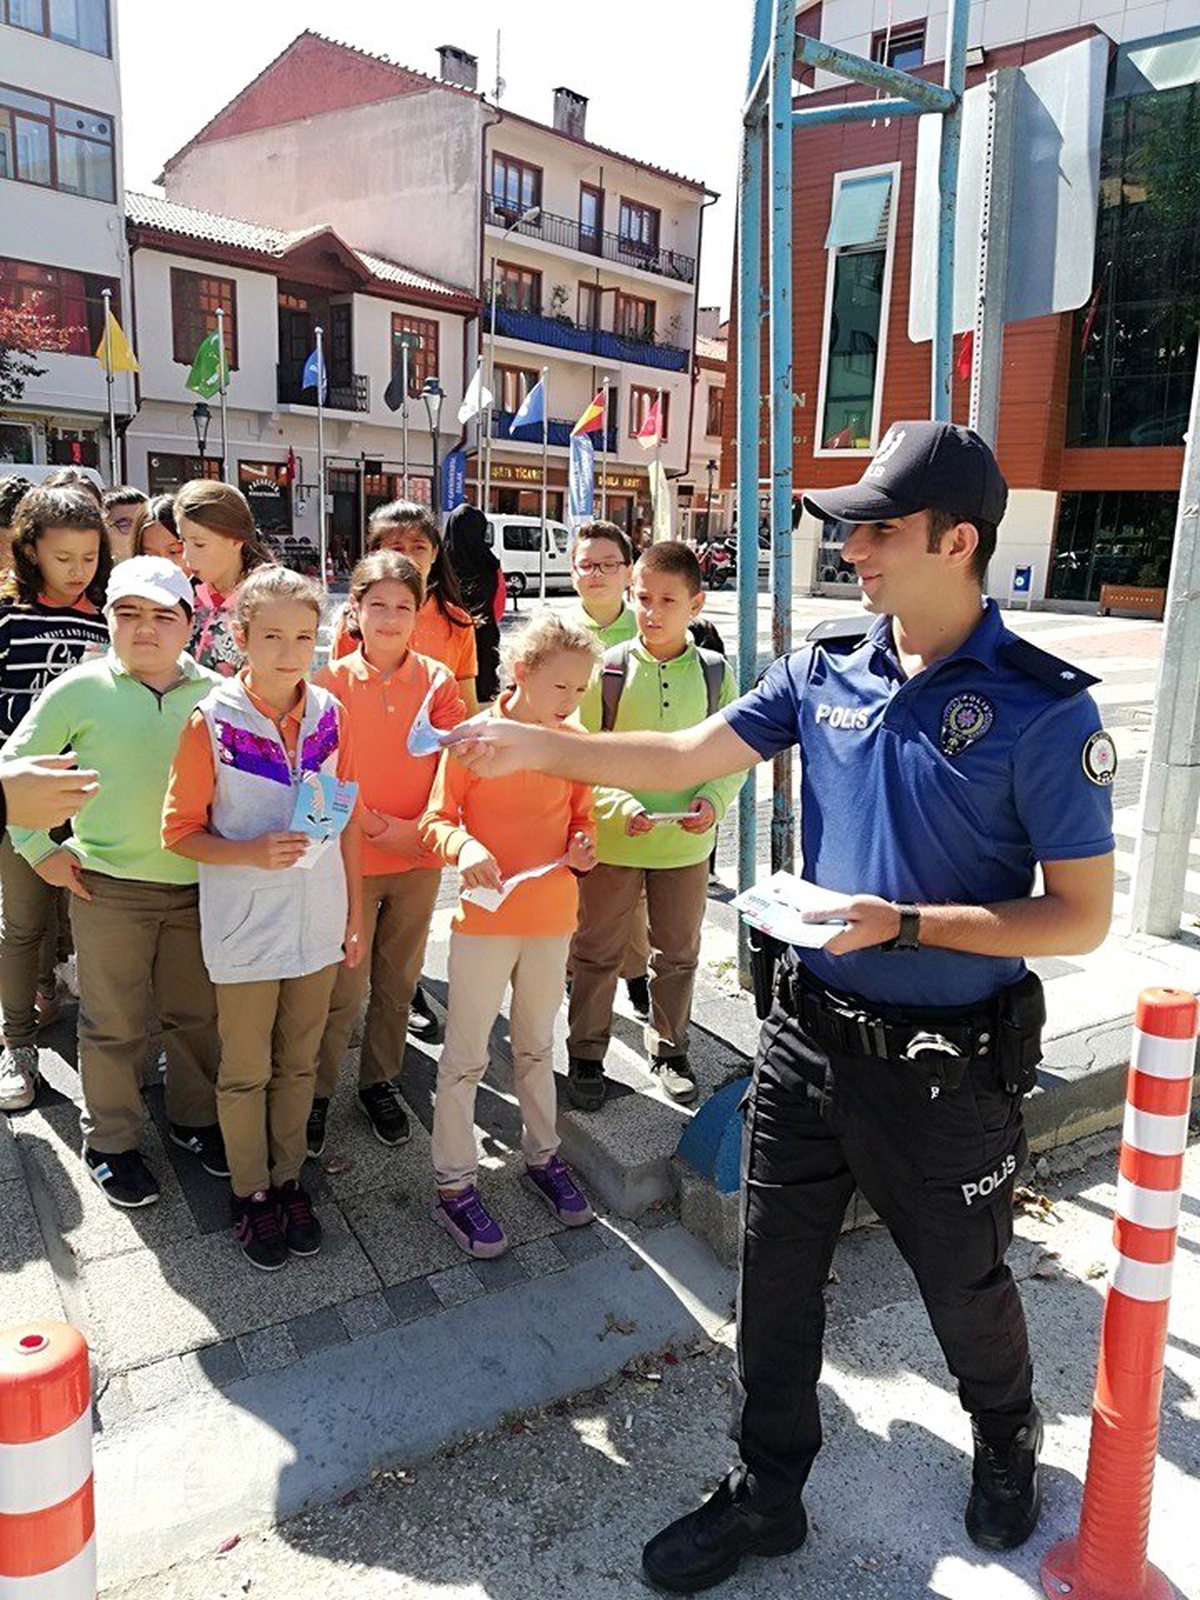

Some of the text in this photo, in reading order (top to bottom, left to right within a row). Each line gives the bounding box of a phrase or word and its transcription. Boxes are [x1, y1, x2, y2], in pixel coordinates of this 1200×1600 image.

[66, 628, 81, 638] AND
[815, 703, 869, 729] POLİS
[961, 1155, 1015, 1205] POLİS
